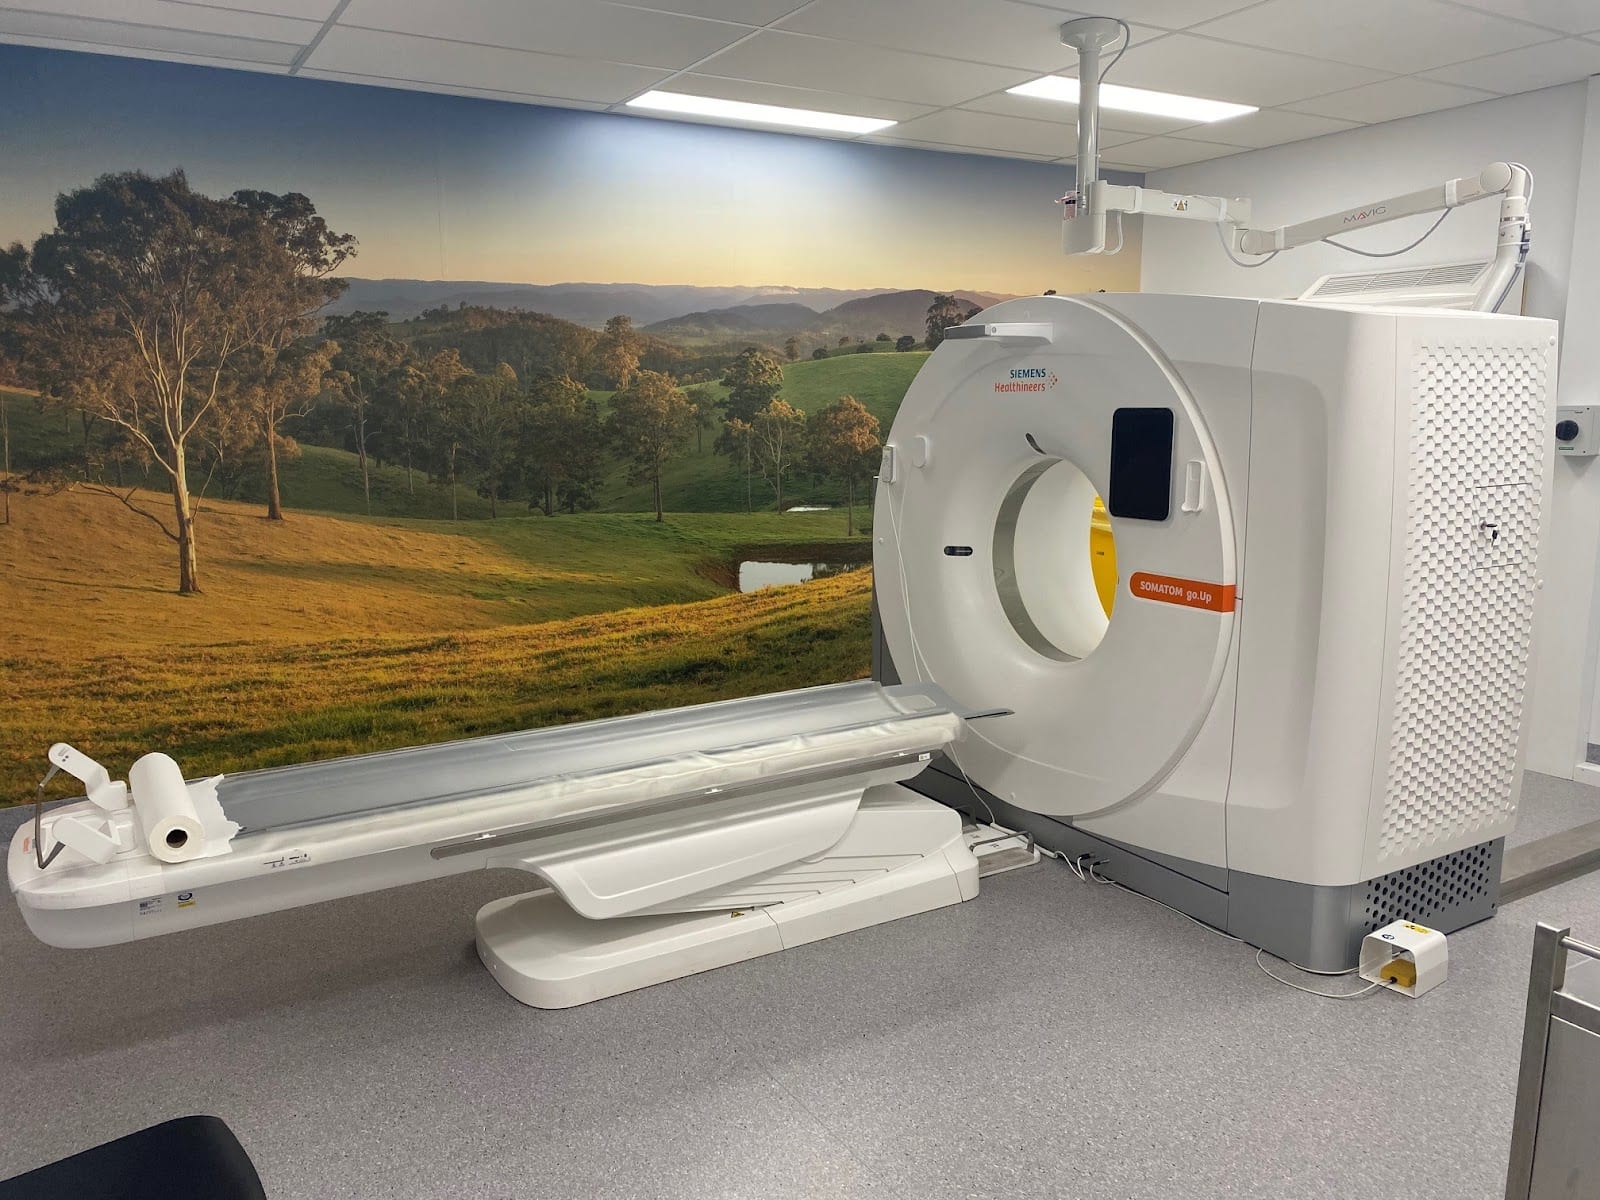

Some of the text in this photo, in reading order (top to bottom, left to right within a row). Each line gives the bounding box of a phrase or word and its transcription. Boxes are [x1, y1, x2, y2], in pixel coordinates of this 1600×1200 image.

[1343, 206, 1387, 223] MAVIG
[1010, 368, 1046, 379] SIEMENS
[994, 381, 1046, 392] Healthineers
[1140, 581, 1212, 604] SOMATOM go.Up
